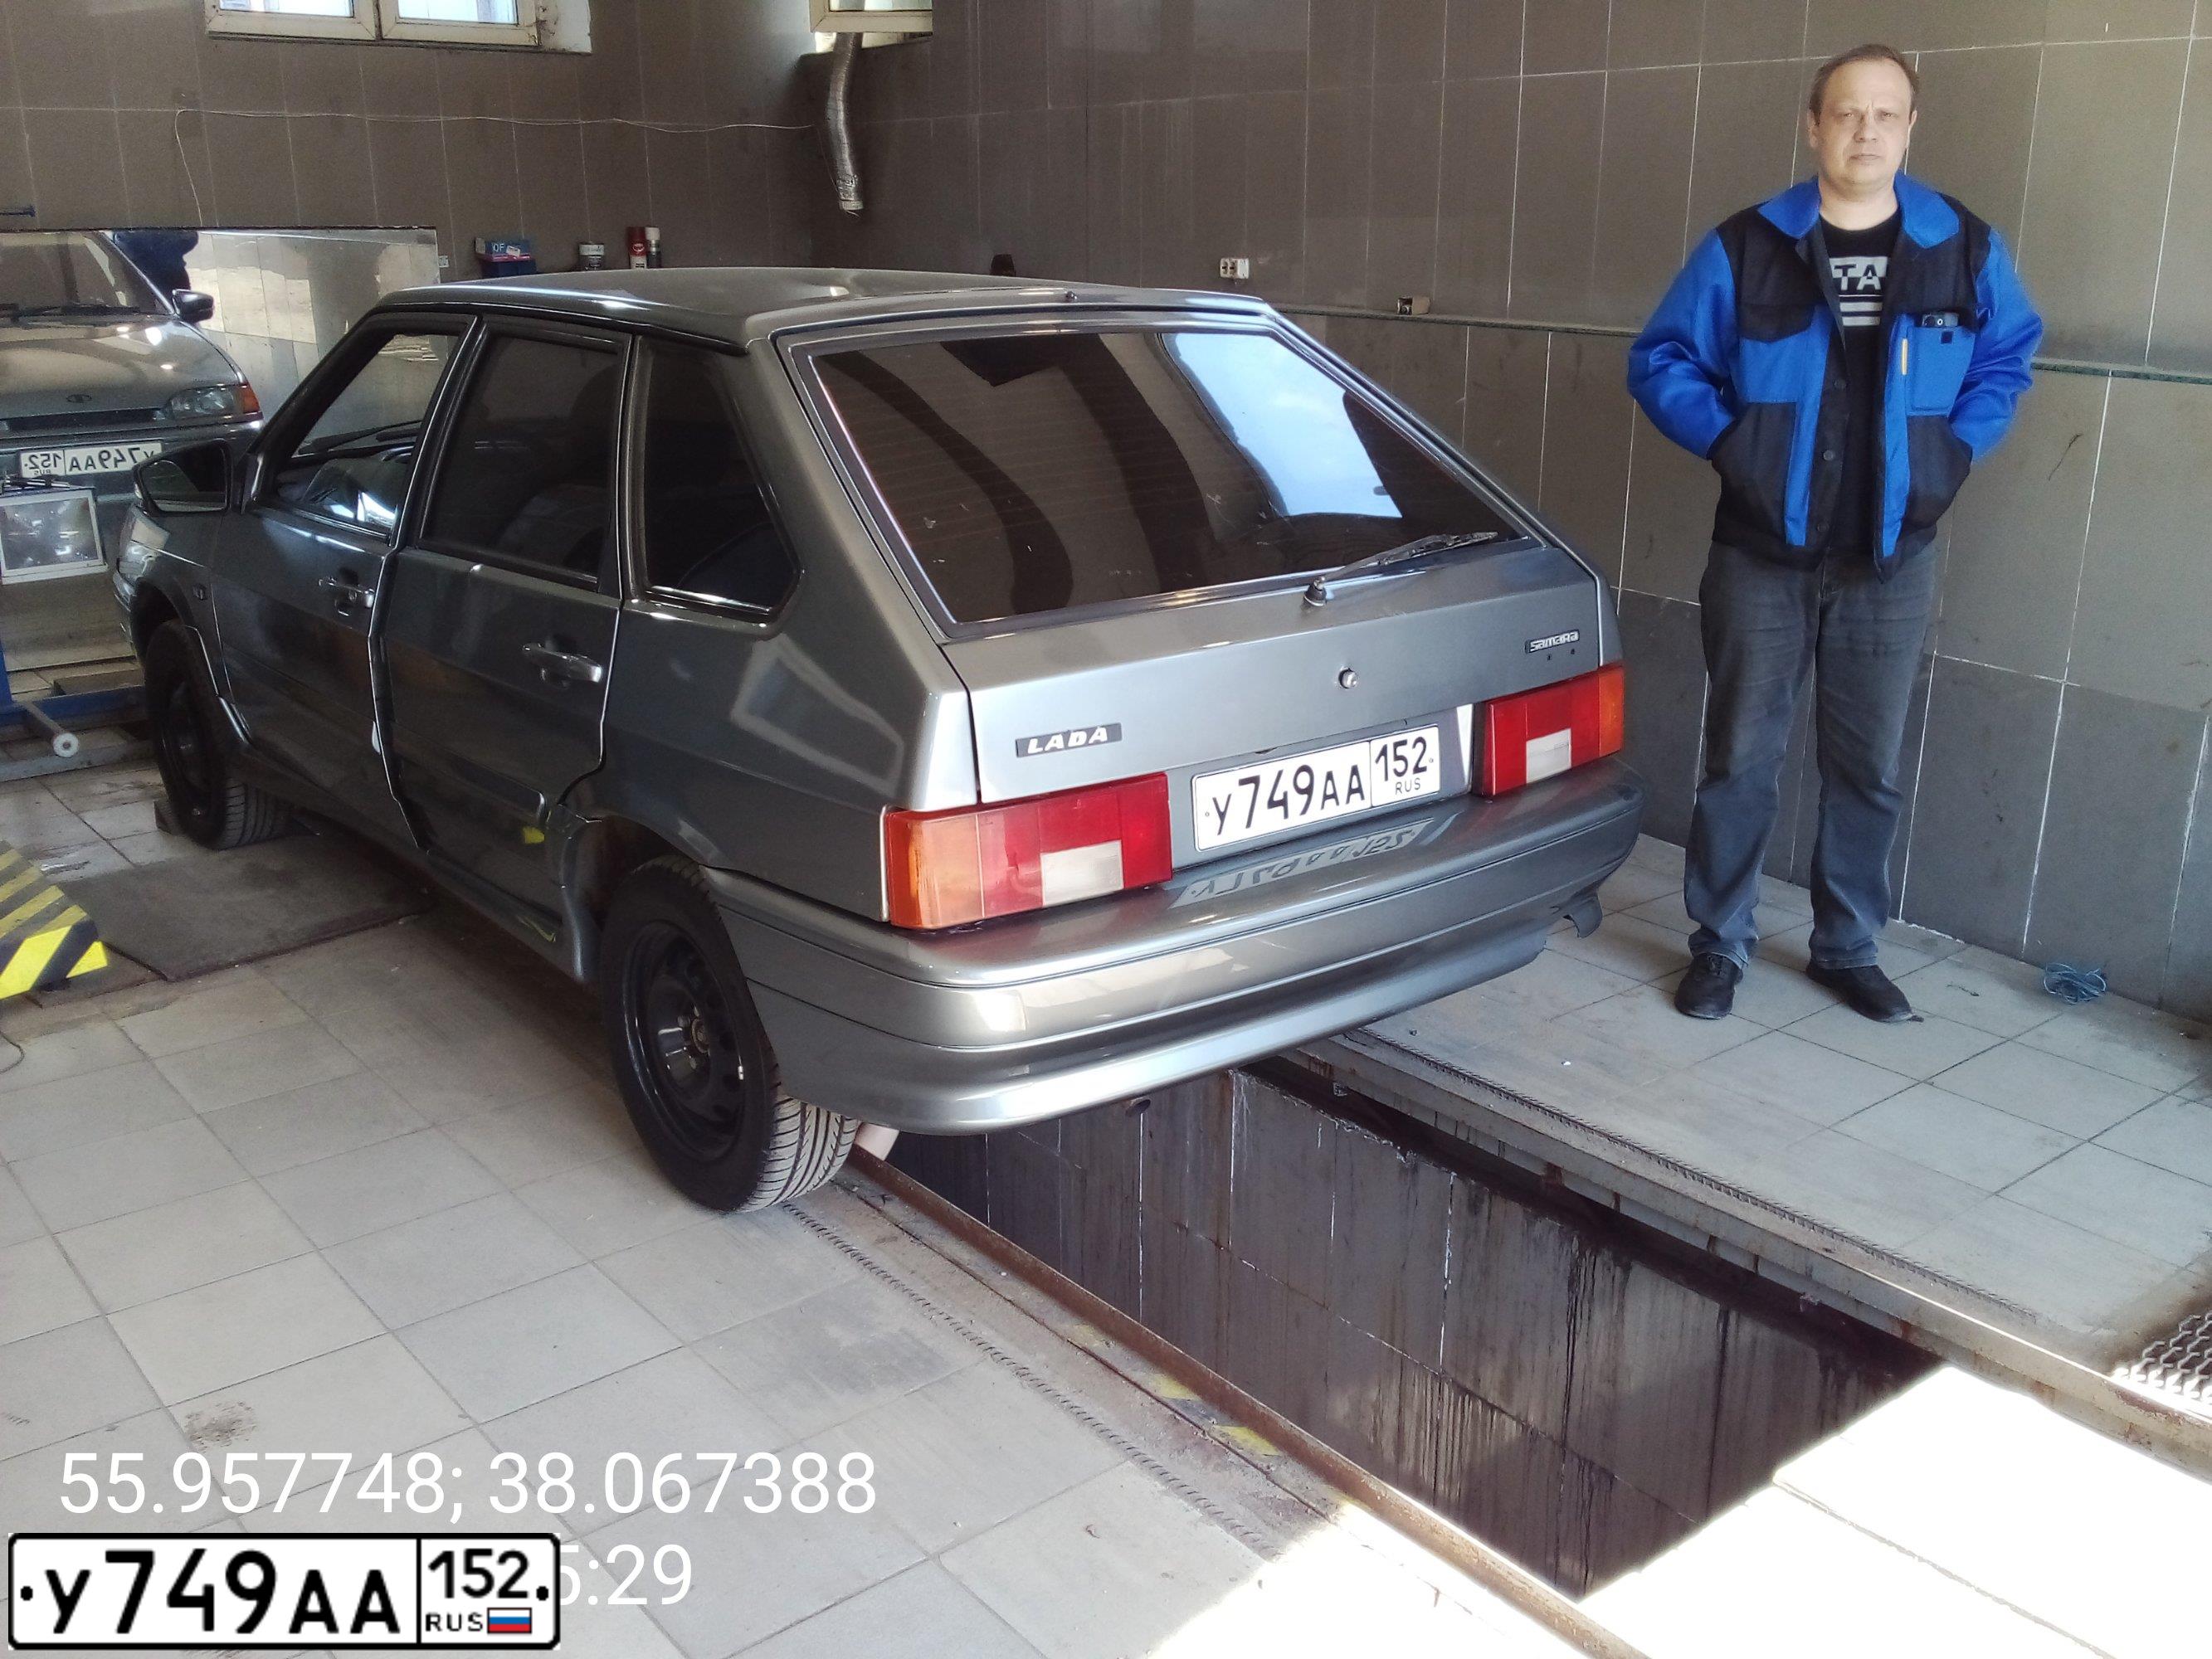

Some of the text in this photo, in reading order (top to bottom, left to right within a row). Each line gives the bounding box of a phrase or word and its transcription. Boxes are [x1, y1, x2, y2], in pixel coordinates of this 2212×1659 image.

[1027, 727, 1108, 754] LADA
[1375, 737, 1427, 781] 152
[1395, 777, 1421, 795] RUS
